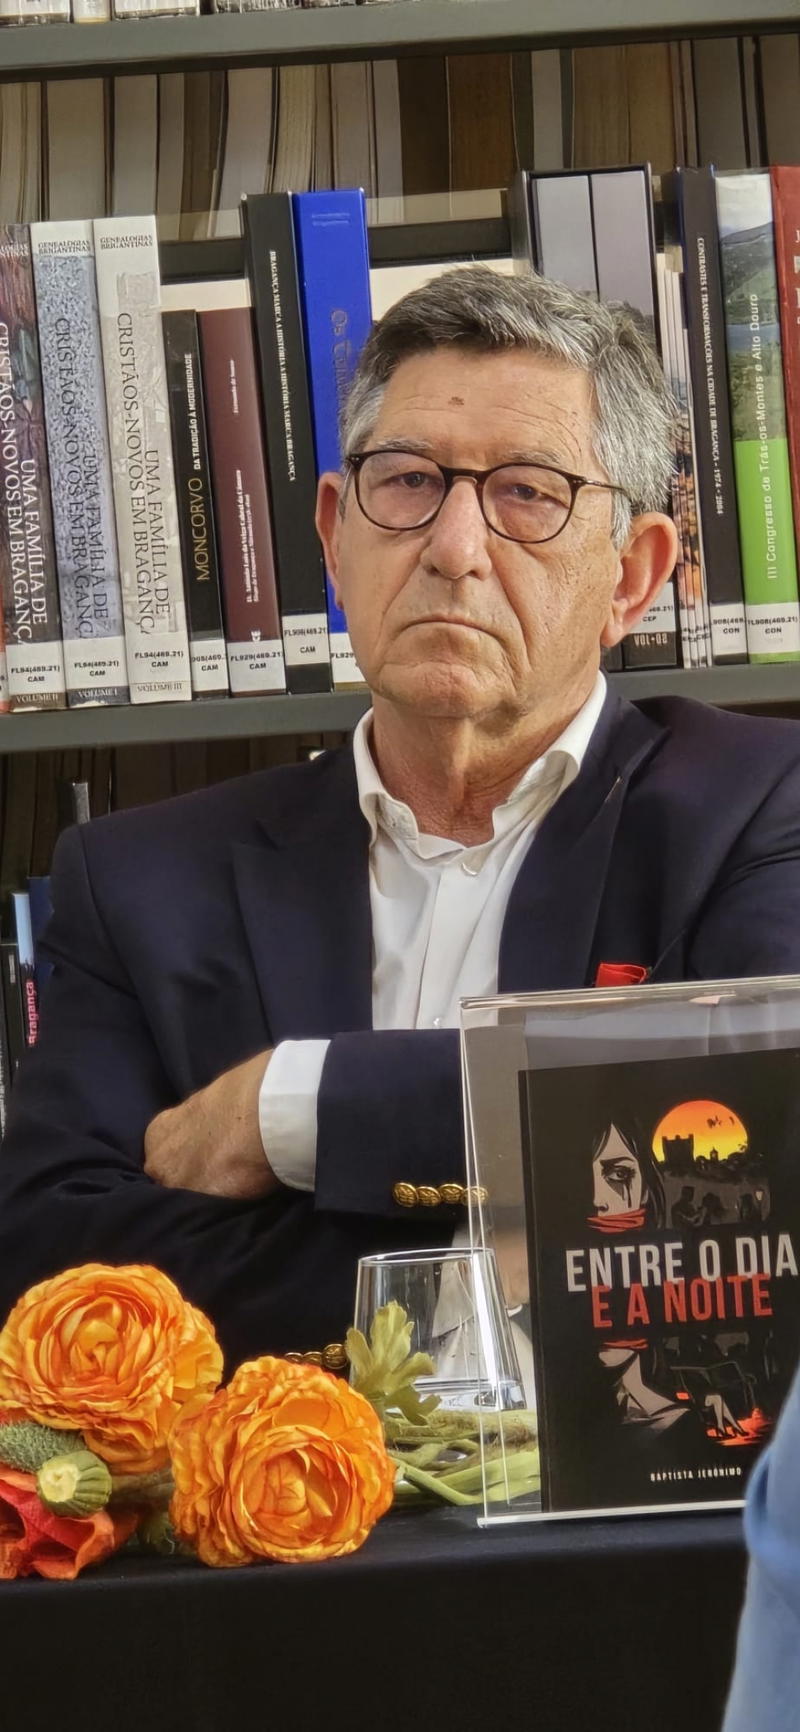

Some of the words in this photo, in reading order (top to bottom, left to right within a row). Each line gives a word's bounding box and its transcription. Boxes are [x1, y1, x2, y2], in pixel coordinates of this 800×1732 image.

[38, 240, 90, 249] GENEALOGIAS
[100, 235, 153, 244] GENEALOGIAS
[101, 241, 153, 250] BRIGANTINAS
[270, 250, 279, 293] BRAGANÇA
[697, 237, 707, 286] CONTRASTES
[273, 294, 282, 322] MARCA
[750, 294, 760, 331] Douro
[277, 330, 286, 365] HISTÓRIA
[752, 336, 762, 360] Alto
[184, 353, 196, 411] MODERNIDADE
[707, 365, 714, 377] NA
[755, 364, 763, 372] e
[281, 373, 290, 409] HISTÓRIA
[707, 378, 716, 405] CIDADE
[0, 322, 21, 500] CRISTÃOS-NOVOS
[55, 317, 84, 498] CRISTÃOS-NOVOS
[117, 313, 145, 491] CRISTÃOS-NOVOS
[131, 496, 147, 525] EM
[709, 407, 716, 417] DE
[187, 418, 201, 458] TRADIÇÃO
[284, 410, 292, 438] MARCA
[756, 375, 769, 472] Trás-os-Montes
[710, 420, 719, 461] BRAGANÇA
[144, 450, 161, 495] UMA
[193, 459, 201, 470] DA
[286, 439, 296, 482] BRAGANÇA
[21, 459, 37, 506] UMA
[83, 454, 99, 500] UMA
[762, 477, 771, 491] de
[7, 506, 23, 535] EM
[68, 501, 85, 529] EM
[188, 478, 211, 581] MONCORVO
[764, 496, 777, 561] Congresso
[25, 511, 46, 592] FAMÍLIA
[85, 506, 106, 587] FAMÍLIA
[149, 502, 168, 582] FAMÍLIA
[72, 535, 93, 639] BRAGANÇ
[767, 566, 777, 579] III
[10, 541, 32, 642] BRAGANÇ
[93, 592, 108, 619] DE
[154, 587, 170, 614] DE
[31, 598, 47, 625] DE
[723, 627, 740, 635] CON
[300, 646, 316, 654] CAM
[201, 664, 219, 672] CAM
[249, 662, 266, 670] CAM
[16, 693, 51, 703] VOLUME
[78, 689, 112, 698] VOLUME
[137, 683, 171, 692] VOLUME
[565, 1242, 685, 1292] ENTRE
[699, 1239, 721, 1282] O
[735, 1233, 799, 1279] DIA
[591, 1284, 613, 1328] E
[627, 1282, 650, 1326] A
[663, 1272, 773, 1323] NOITE
[650, 1470, 693, 1482] BAPTISTA
[698, 1466, 741, 1478] JERÓNIMO
